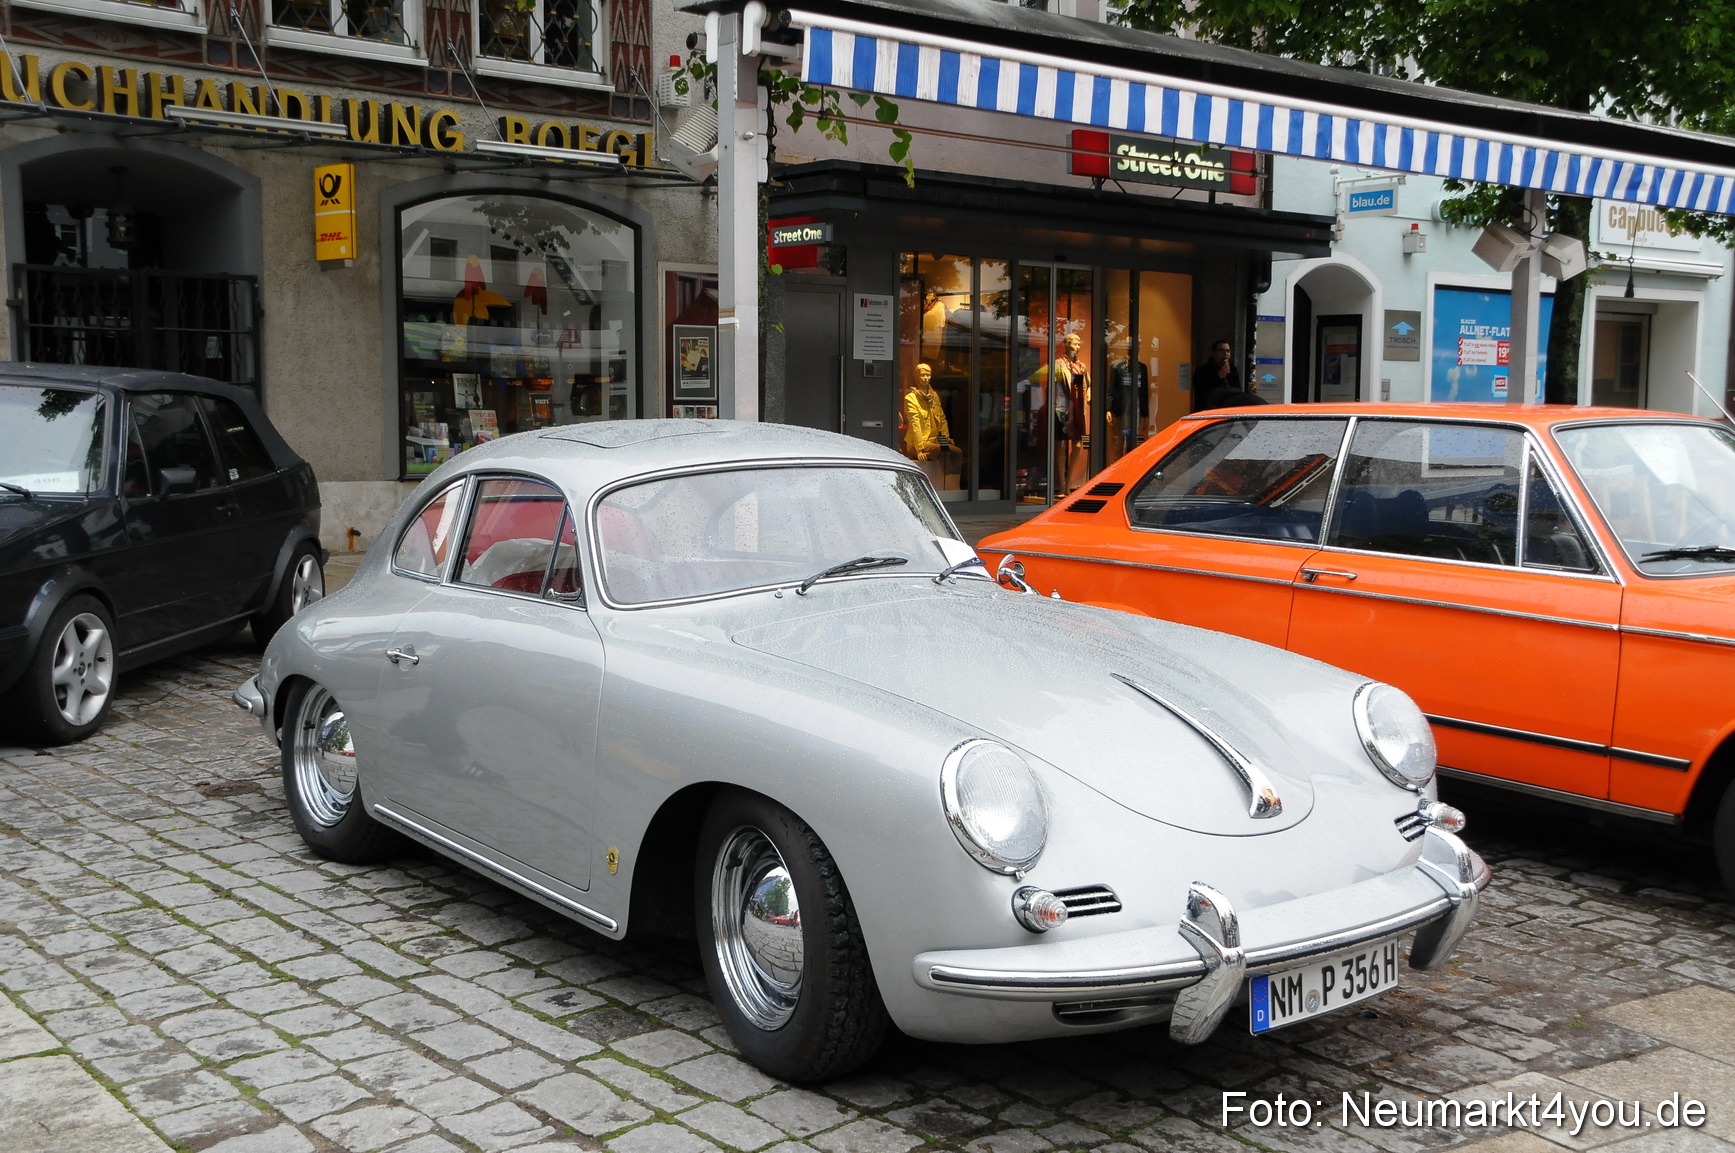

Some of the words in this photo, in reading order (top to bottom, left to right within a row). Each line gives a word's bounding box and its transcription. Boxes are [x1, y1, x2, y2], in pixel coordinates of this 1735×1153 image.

[1117, 144, 1182, 177] Street
[1184, 153, 1225, 182] One
[1352, 195, 1390, 208] blau.de
[319, 232, 342, 242] DHL
[774, 228, 802, 244] Street
[803, 228, 823, 241] One
[1460, 325, 1510, 338] ALLNET-FLAT
[1270, 973, 1303, 1021] NM
[1322, 965, 1335, 1006] P
[1257, 1010, 1265, 1022] D
